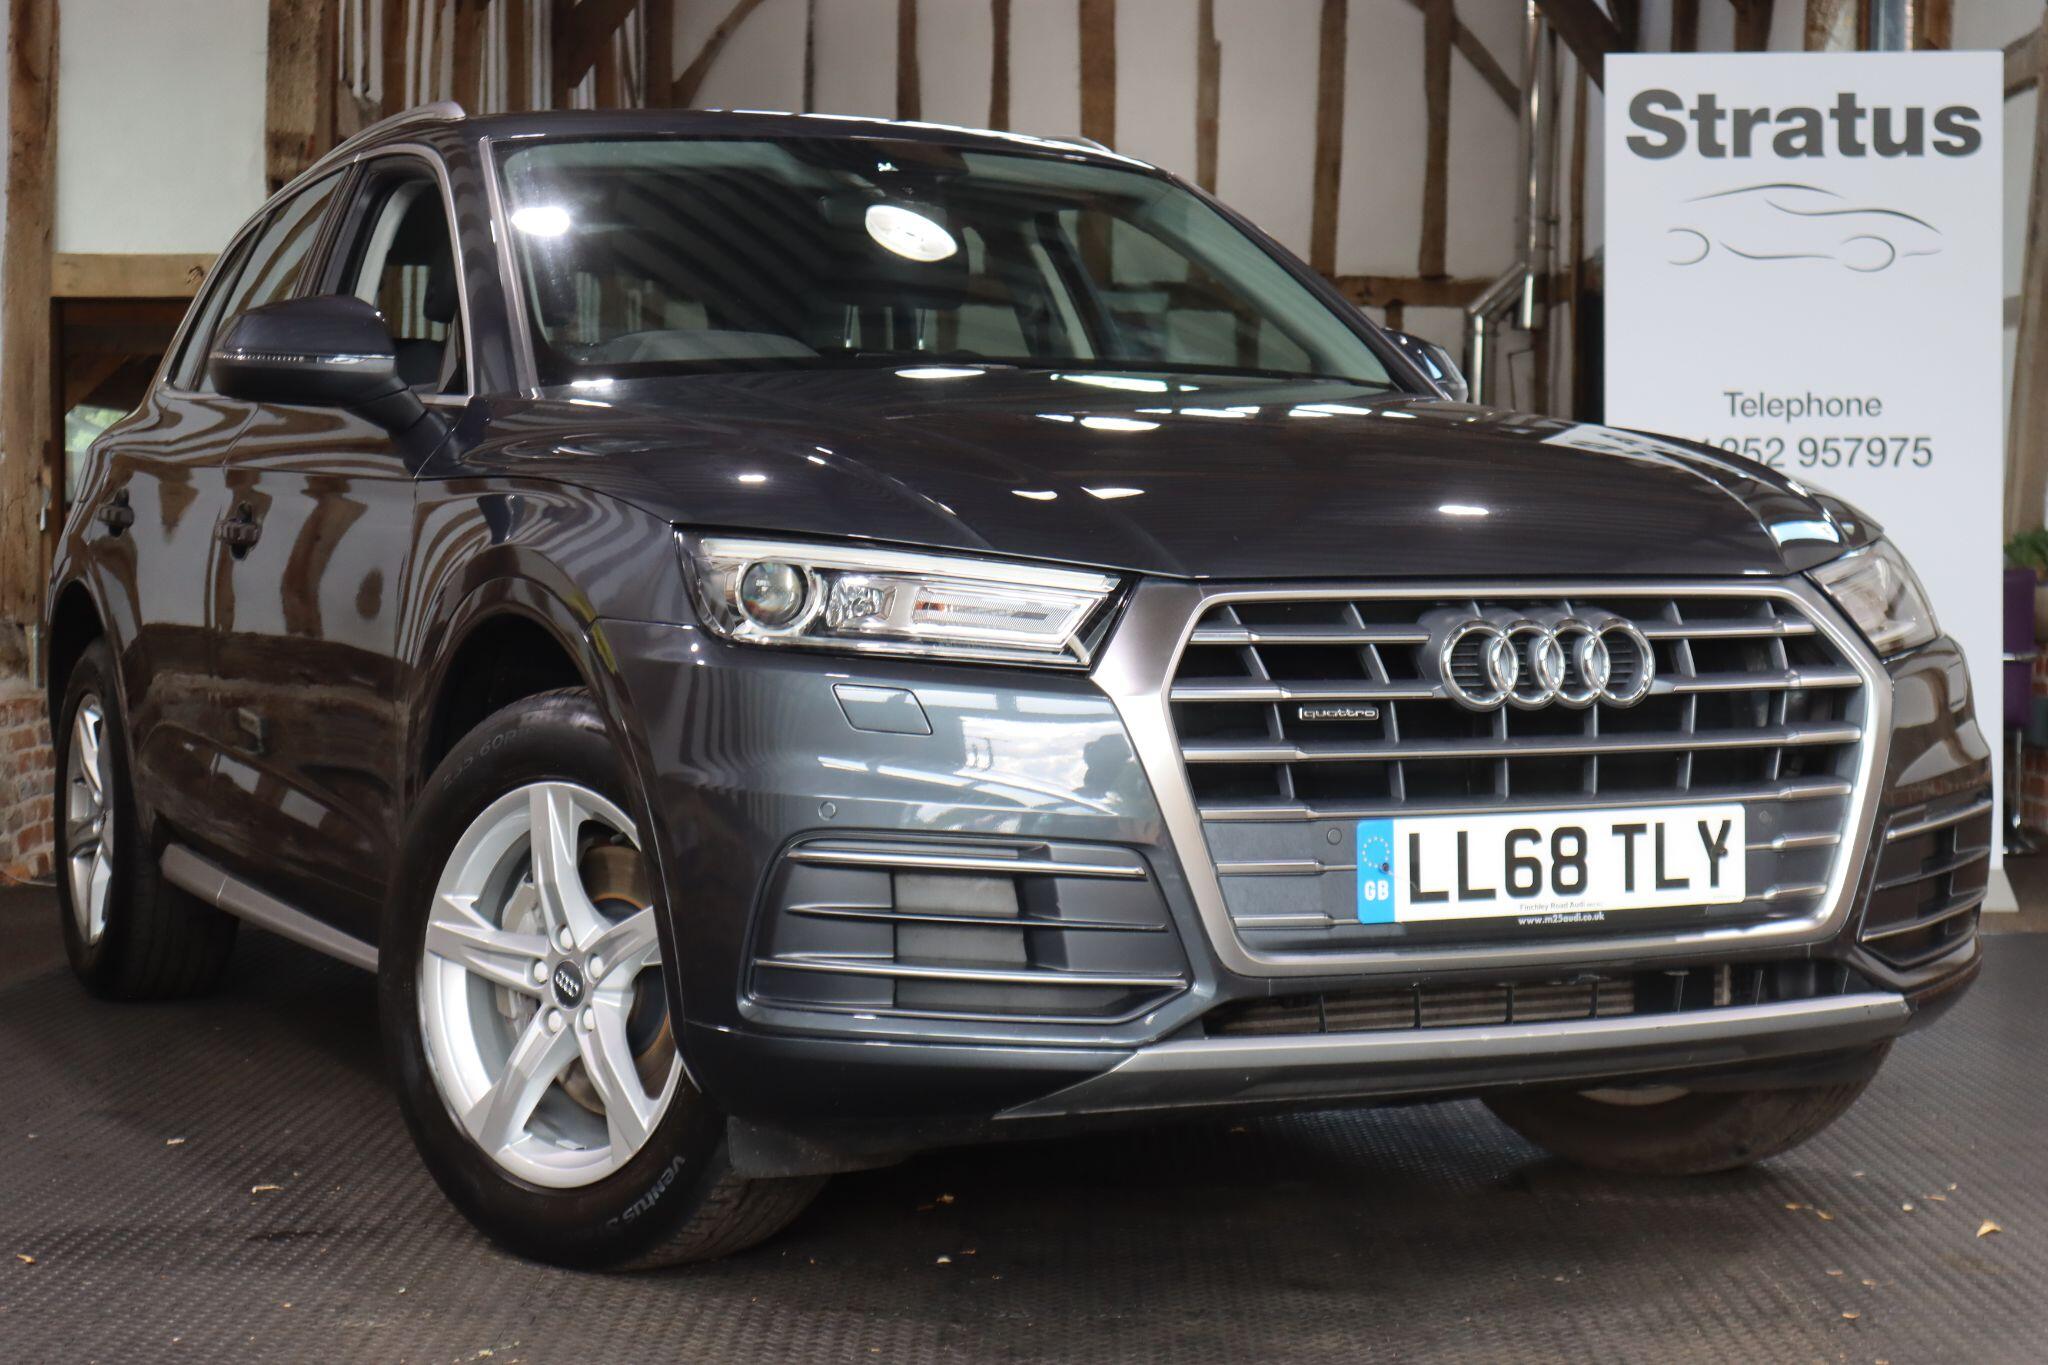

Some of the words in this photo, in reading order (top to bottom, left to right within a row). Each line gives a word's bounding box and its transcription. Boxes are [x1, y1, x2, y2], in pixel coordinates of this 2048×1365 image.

[1626, 88, 1982, 159] Stratus
[1723, 391, 1883, 423] Telephone
[1798, 437, 1933, 468] 957975
[1303, 709, 1376, 719] quattro
[1408, 826, 1588, 905] LL68
[1611, 819, 1732, 893] TLY
[1364, 880, 1389, 901] GB
[1518, 911, 1605, 926] www.m25audi.co.uk
